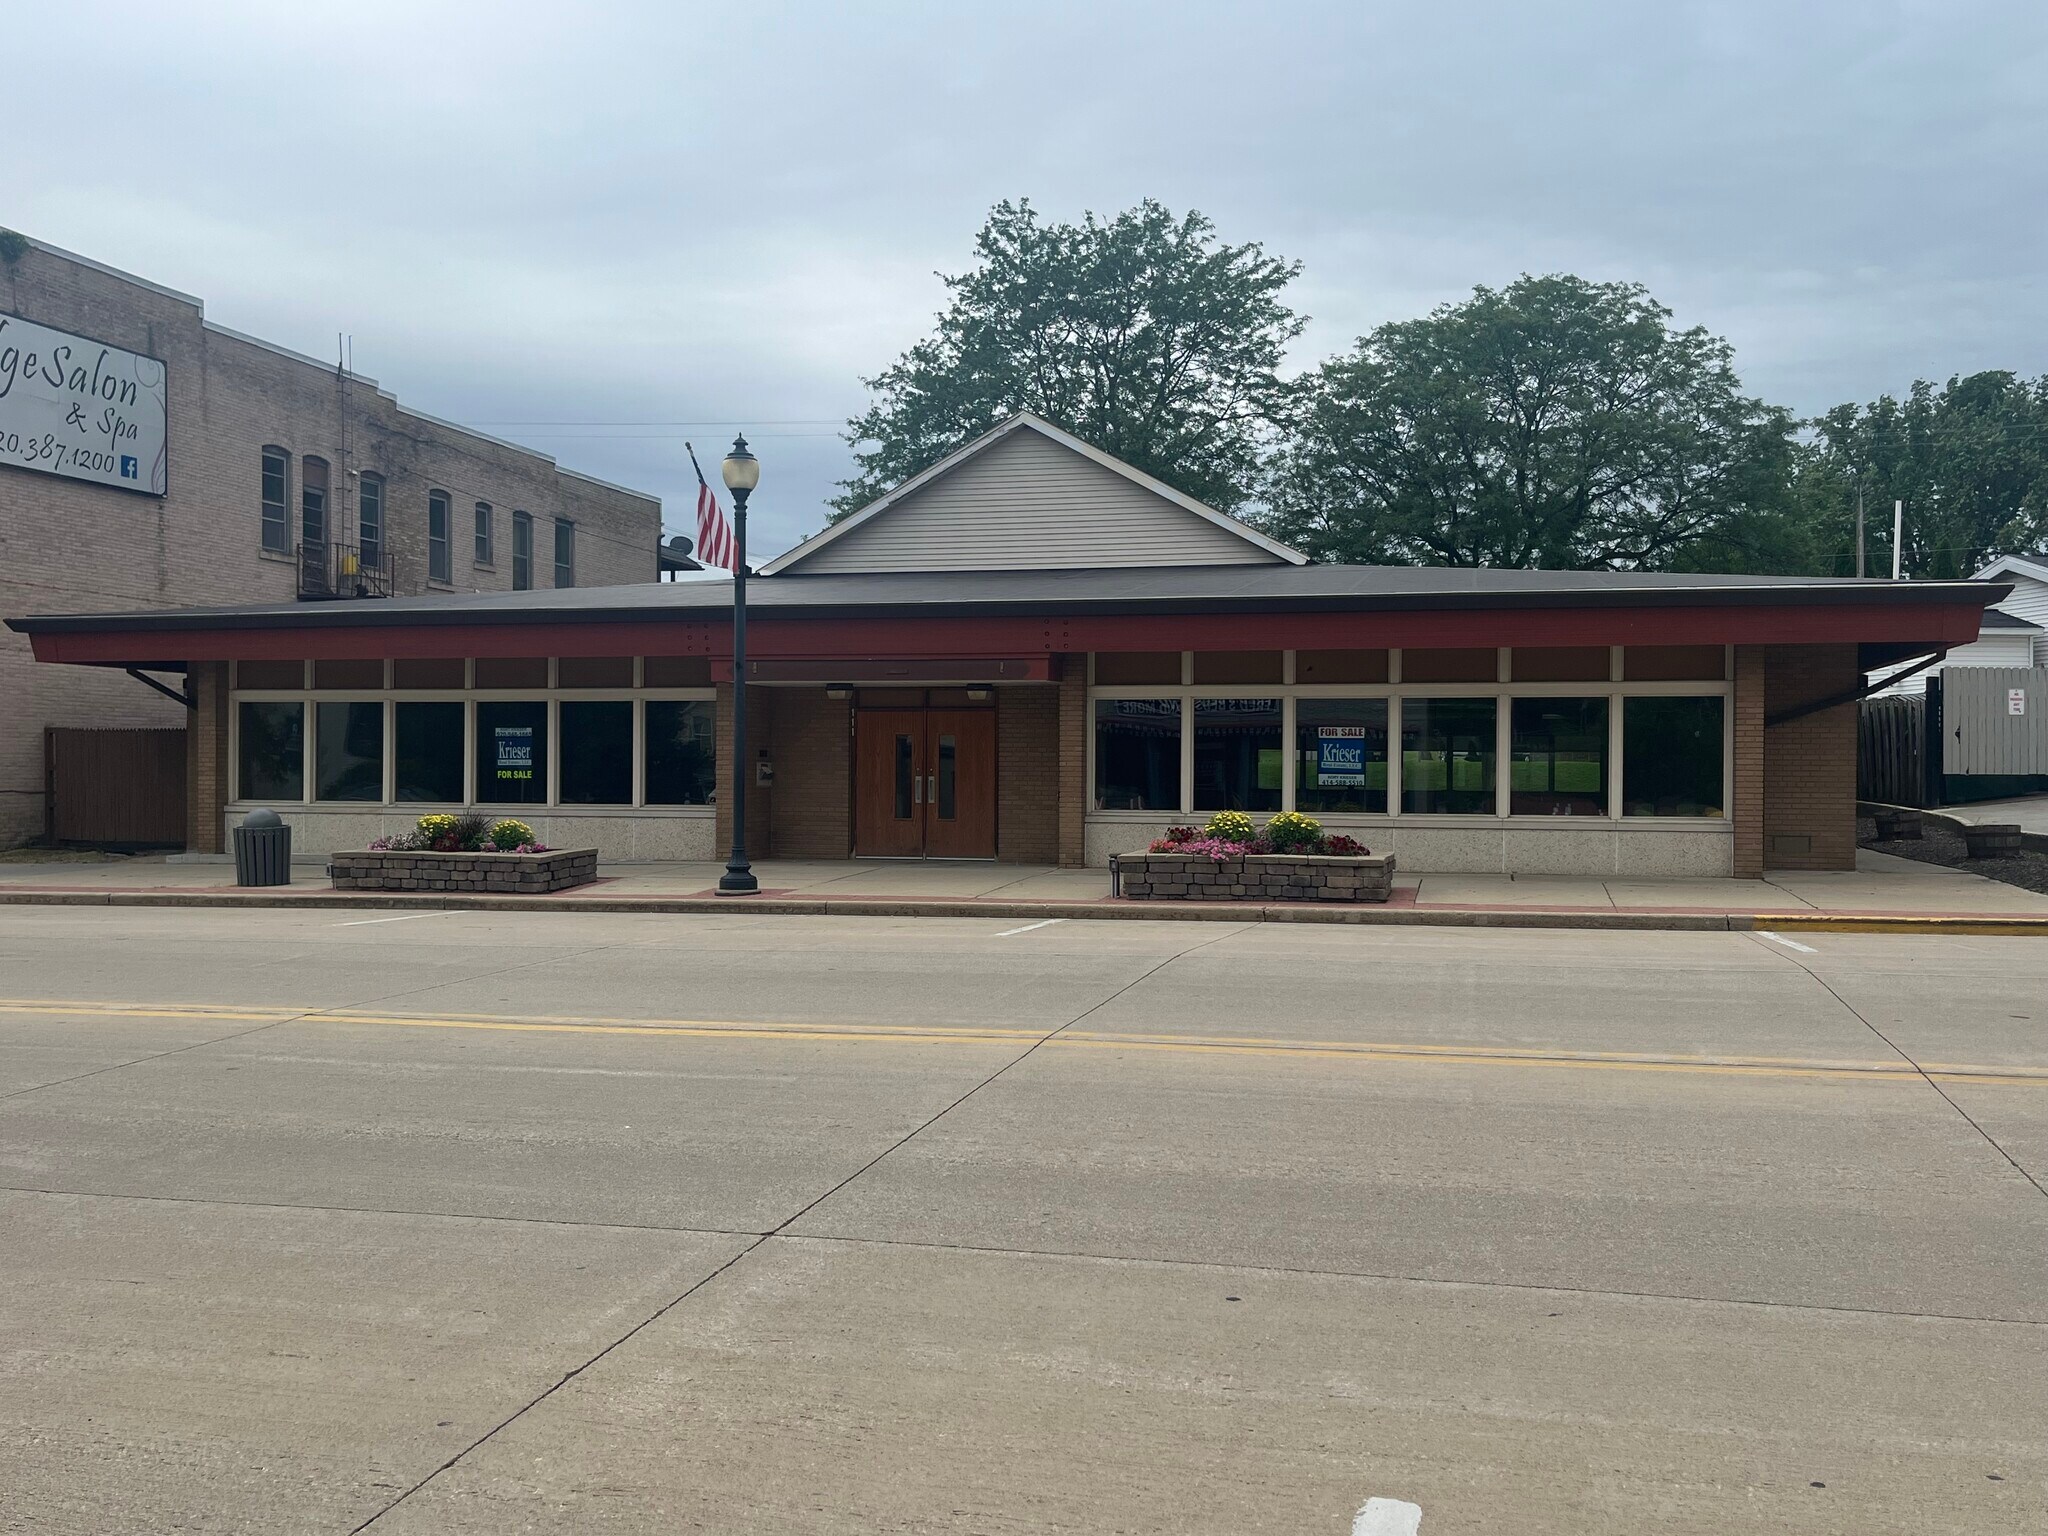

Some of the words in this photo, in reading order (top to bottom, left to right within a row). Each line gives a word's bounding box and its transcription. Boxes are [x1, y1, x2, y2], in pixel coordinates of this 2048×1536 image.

[65, 402, 87, 433] &
[96, 407, 138, 451] Spa
[1320, 728, 1338, 737] FOR
[1341, 728, 1364, 737] SALE
[499, 741, 531, 759] Krieser
[1323, 743, 1361, 762] Krieser
[497, 770, 512, 779] FOR
[513, 770, 532, 779] SALE
